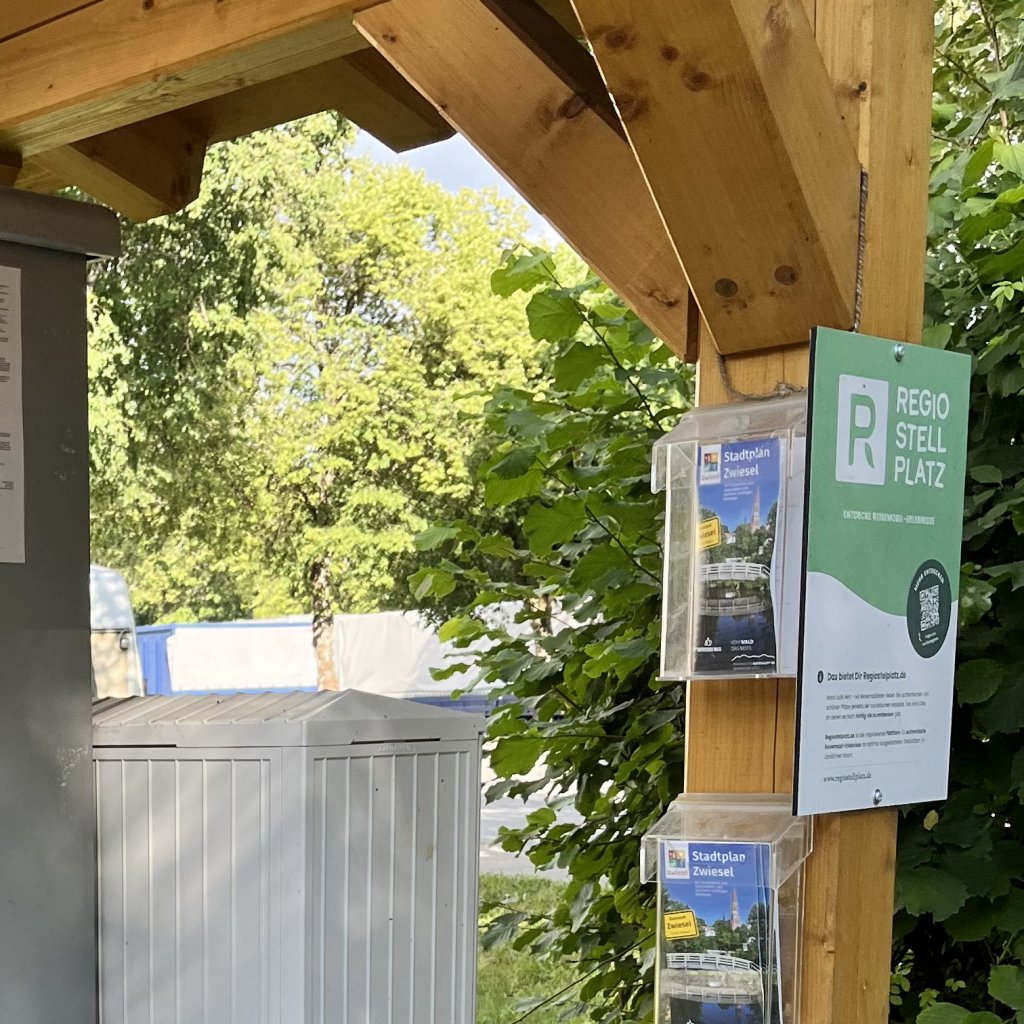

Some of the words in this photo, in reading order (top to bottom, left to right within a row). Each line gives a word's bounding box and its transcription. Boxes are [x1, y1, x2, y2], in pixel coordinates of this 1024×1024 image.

[897, 386, 950, 420] REGIO
[895, 421, 947, 454] STELL
[724, 447, 770, 463] Stadtplan
[723, 464, 759, 479] Zwiesel
[894, 456, 947, 489] PLATZ
[692, 850, 746, 864] Stadtplan
[693, 866, 734, 877] Zwiesel
